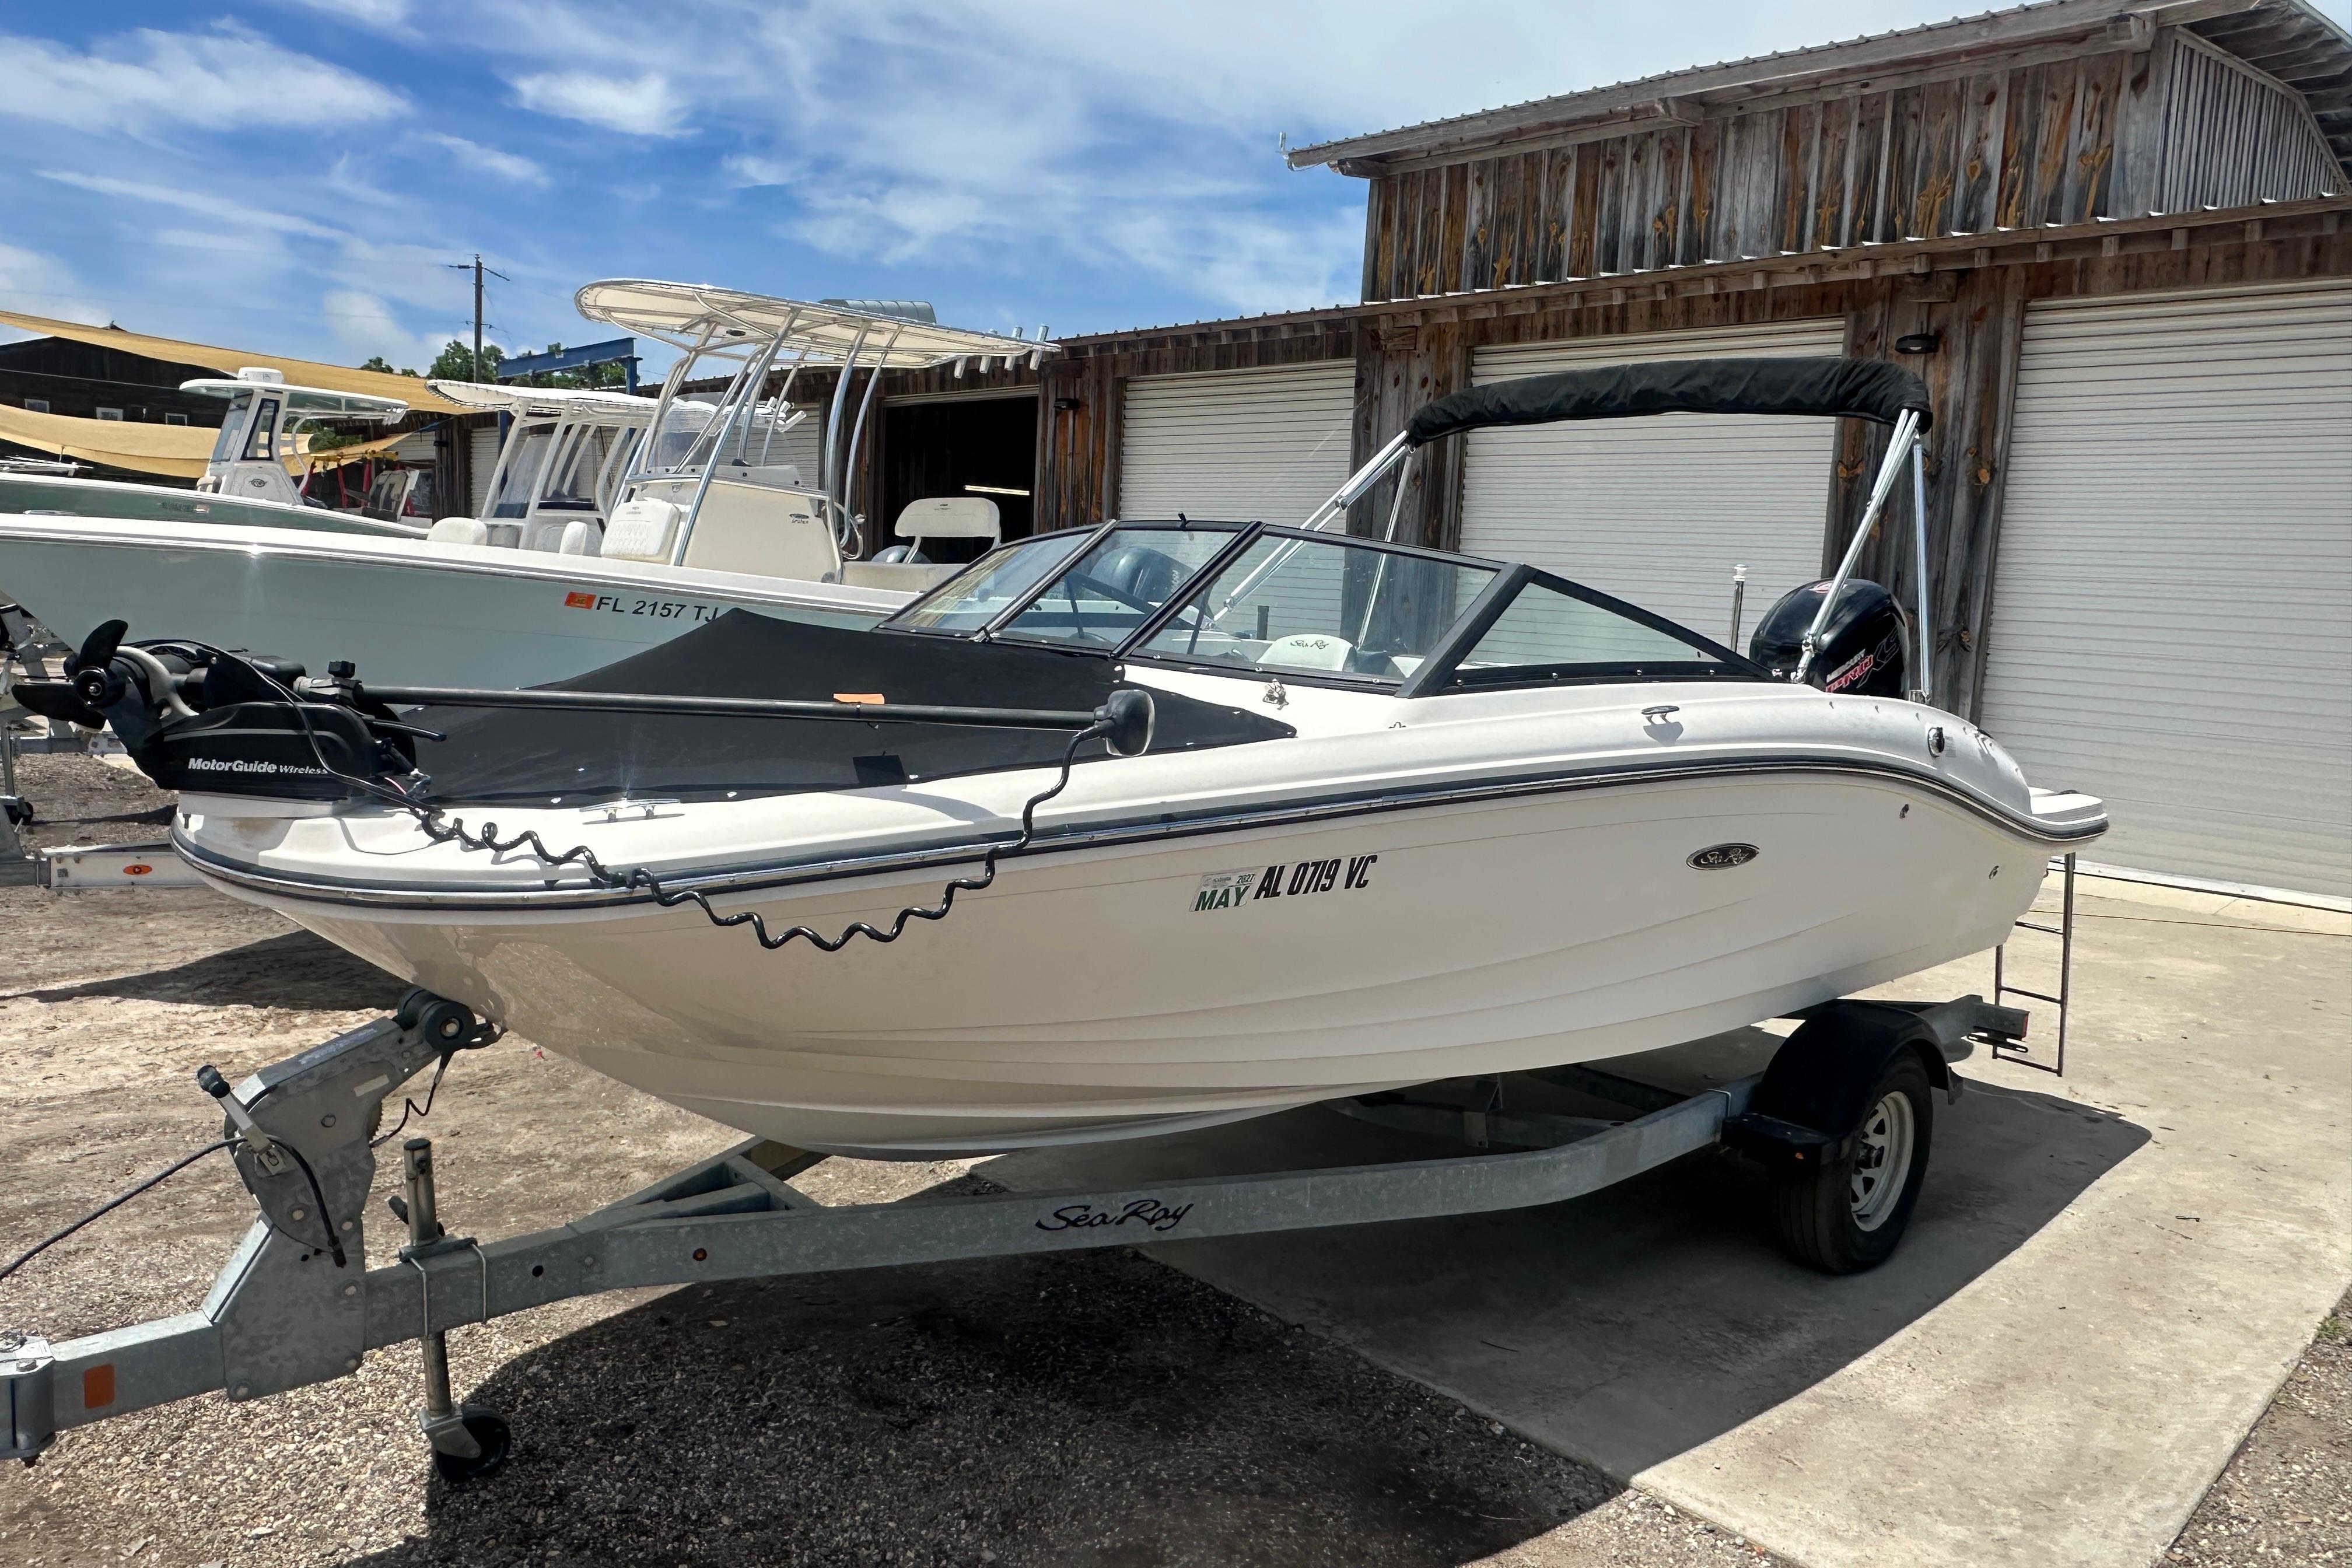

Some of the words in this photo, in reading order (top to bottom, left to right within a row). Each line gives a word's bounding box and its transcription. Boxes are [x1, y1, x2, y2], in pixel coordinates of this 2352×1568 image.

[596, 596, 625, 612] FL
[632, 600, 687, 618] 2157
[694, 606, 719, 622] TJ
[188, 758, 278, 773] MotorGuide
[279, 765, 328, 774] Wireless
[1253, 866, 1286, 900] AL
[1287, 859, 1342, 895] 0719
[1344, 855, 1378, 889] VC
[1194, 886, 1251, 911] MAY
[1035, 1205, 1117, 1231] Sea
[1115, 1199, 1194, 1231] Ray
